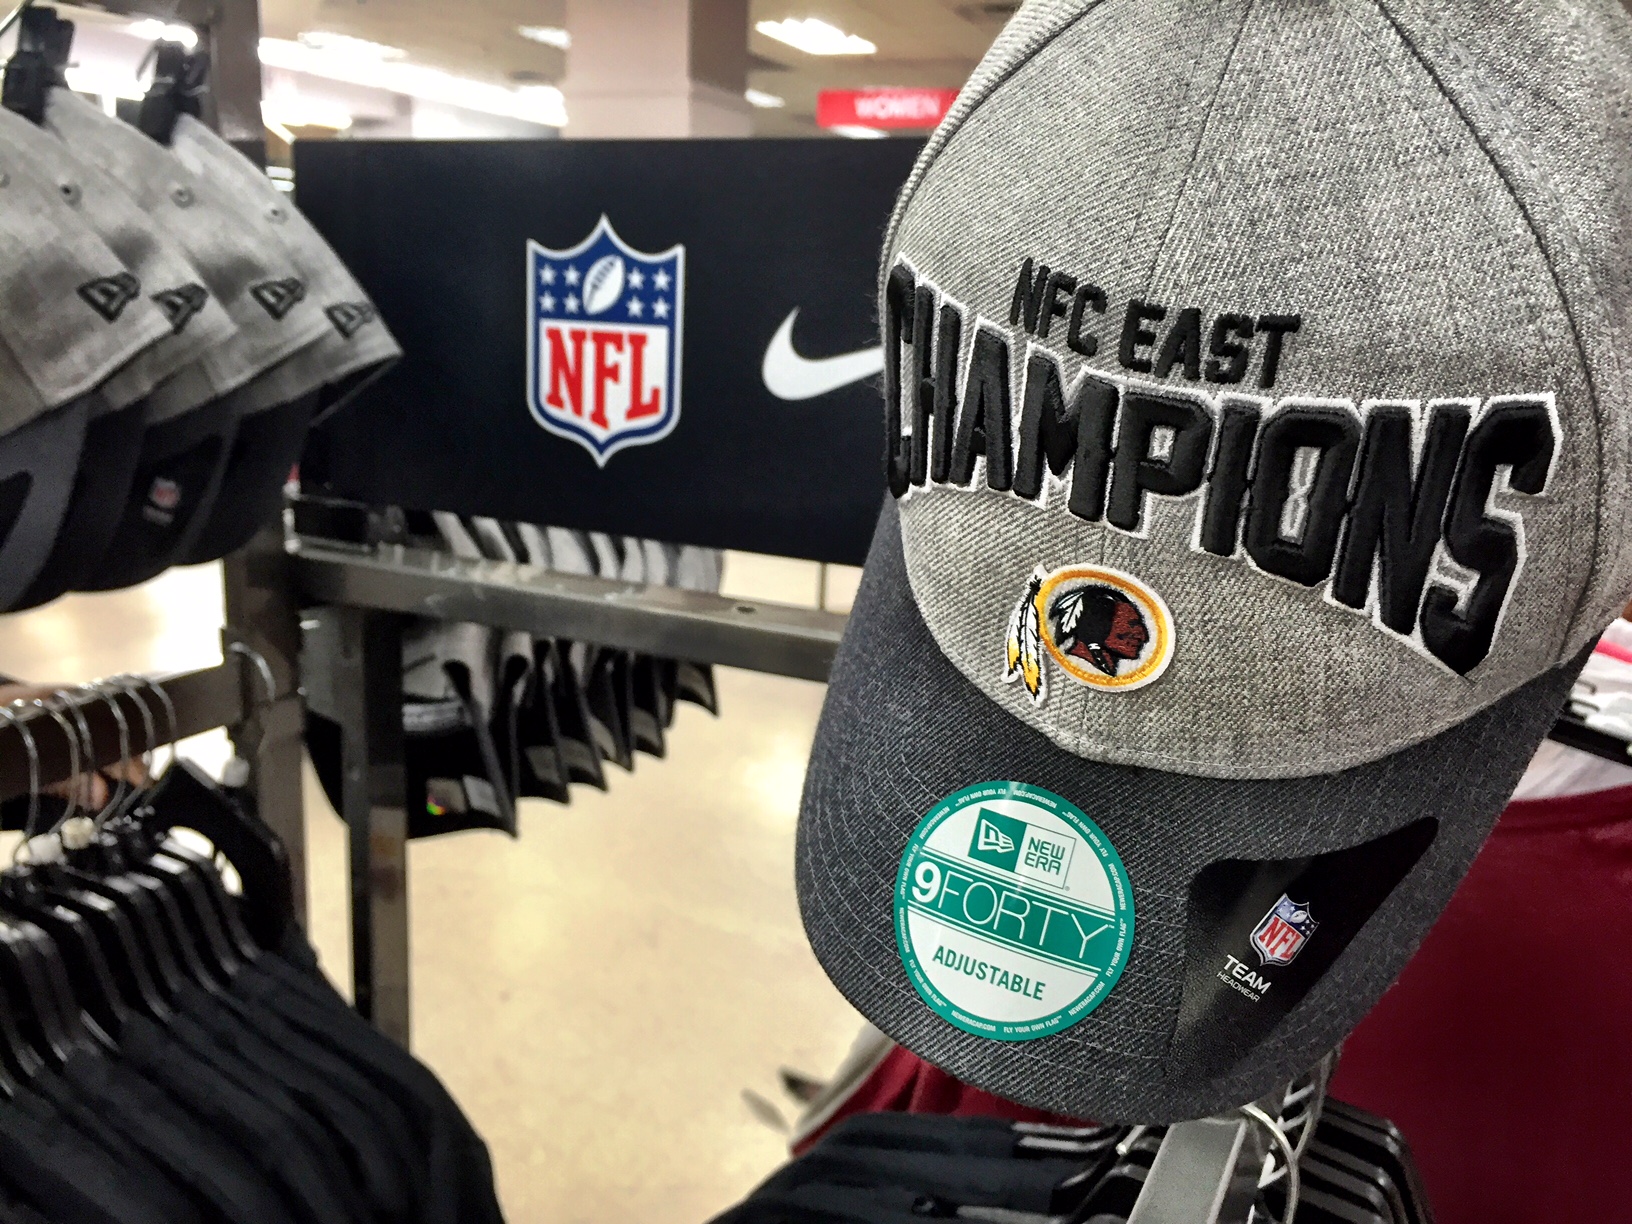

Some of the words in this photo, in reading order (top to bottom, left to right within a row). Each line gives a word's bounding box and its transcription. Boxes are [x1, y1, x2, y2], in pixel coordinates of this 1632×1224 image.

[1009, 256, 1108, 357] NFC
[1118, 298, 1301, 389] EAST
[546, 327, 660, 430] NFL
[884, 254, 1561, 678] CHAMPIONS
[1024, 851, 1062, 876] ERA
[1028, 836, 1066, 860] NEW
[1258, 916, 1302, 960] NFL
[932, 945, 1046, 1001] ADJUSTABLE
[1216, 971, 1260, 1002] HEADWEAR
[1223, 954, 1272, 995] TEAM
